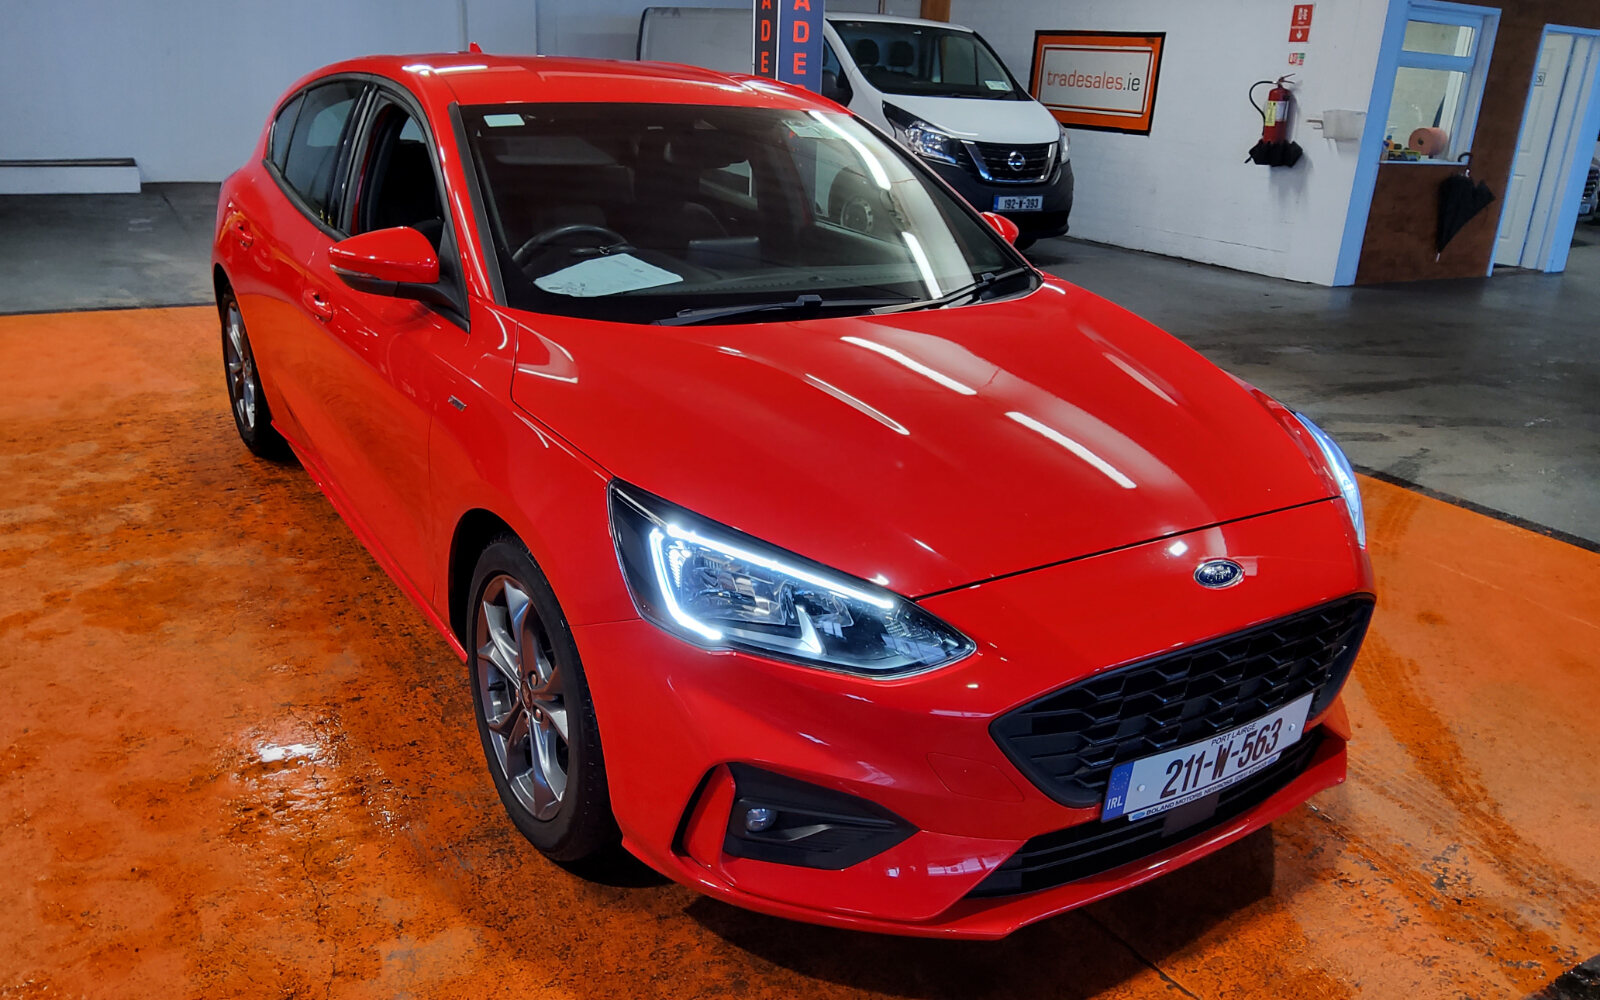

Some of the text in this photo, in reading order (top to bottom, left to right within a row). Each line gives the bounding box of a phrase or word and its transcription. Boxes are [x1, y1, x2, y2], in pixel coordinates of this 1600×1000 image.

[793, 0, 811, 89] ADE
[1047, 69, 1141, 91] tradesales.ie
[1211, 733, 1231, 746] PORT
[1160, 717, 1283, 799] 211-W-563
[1107, 795, 1123, 810] IRL
[1146, 802, 1174, 817] BOLAND
